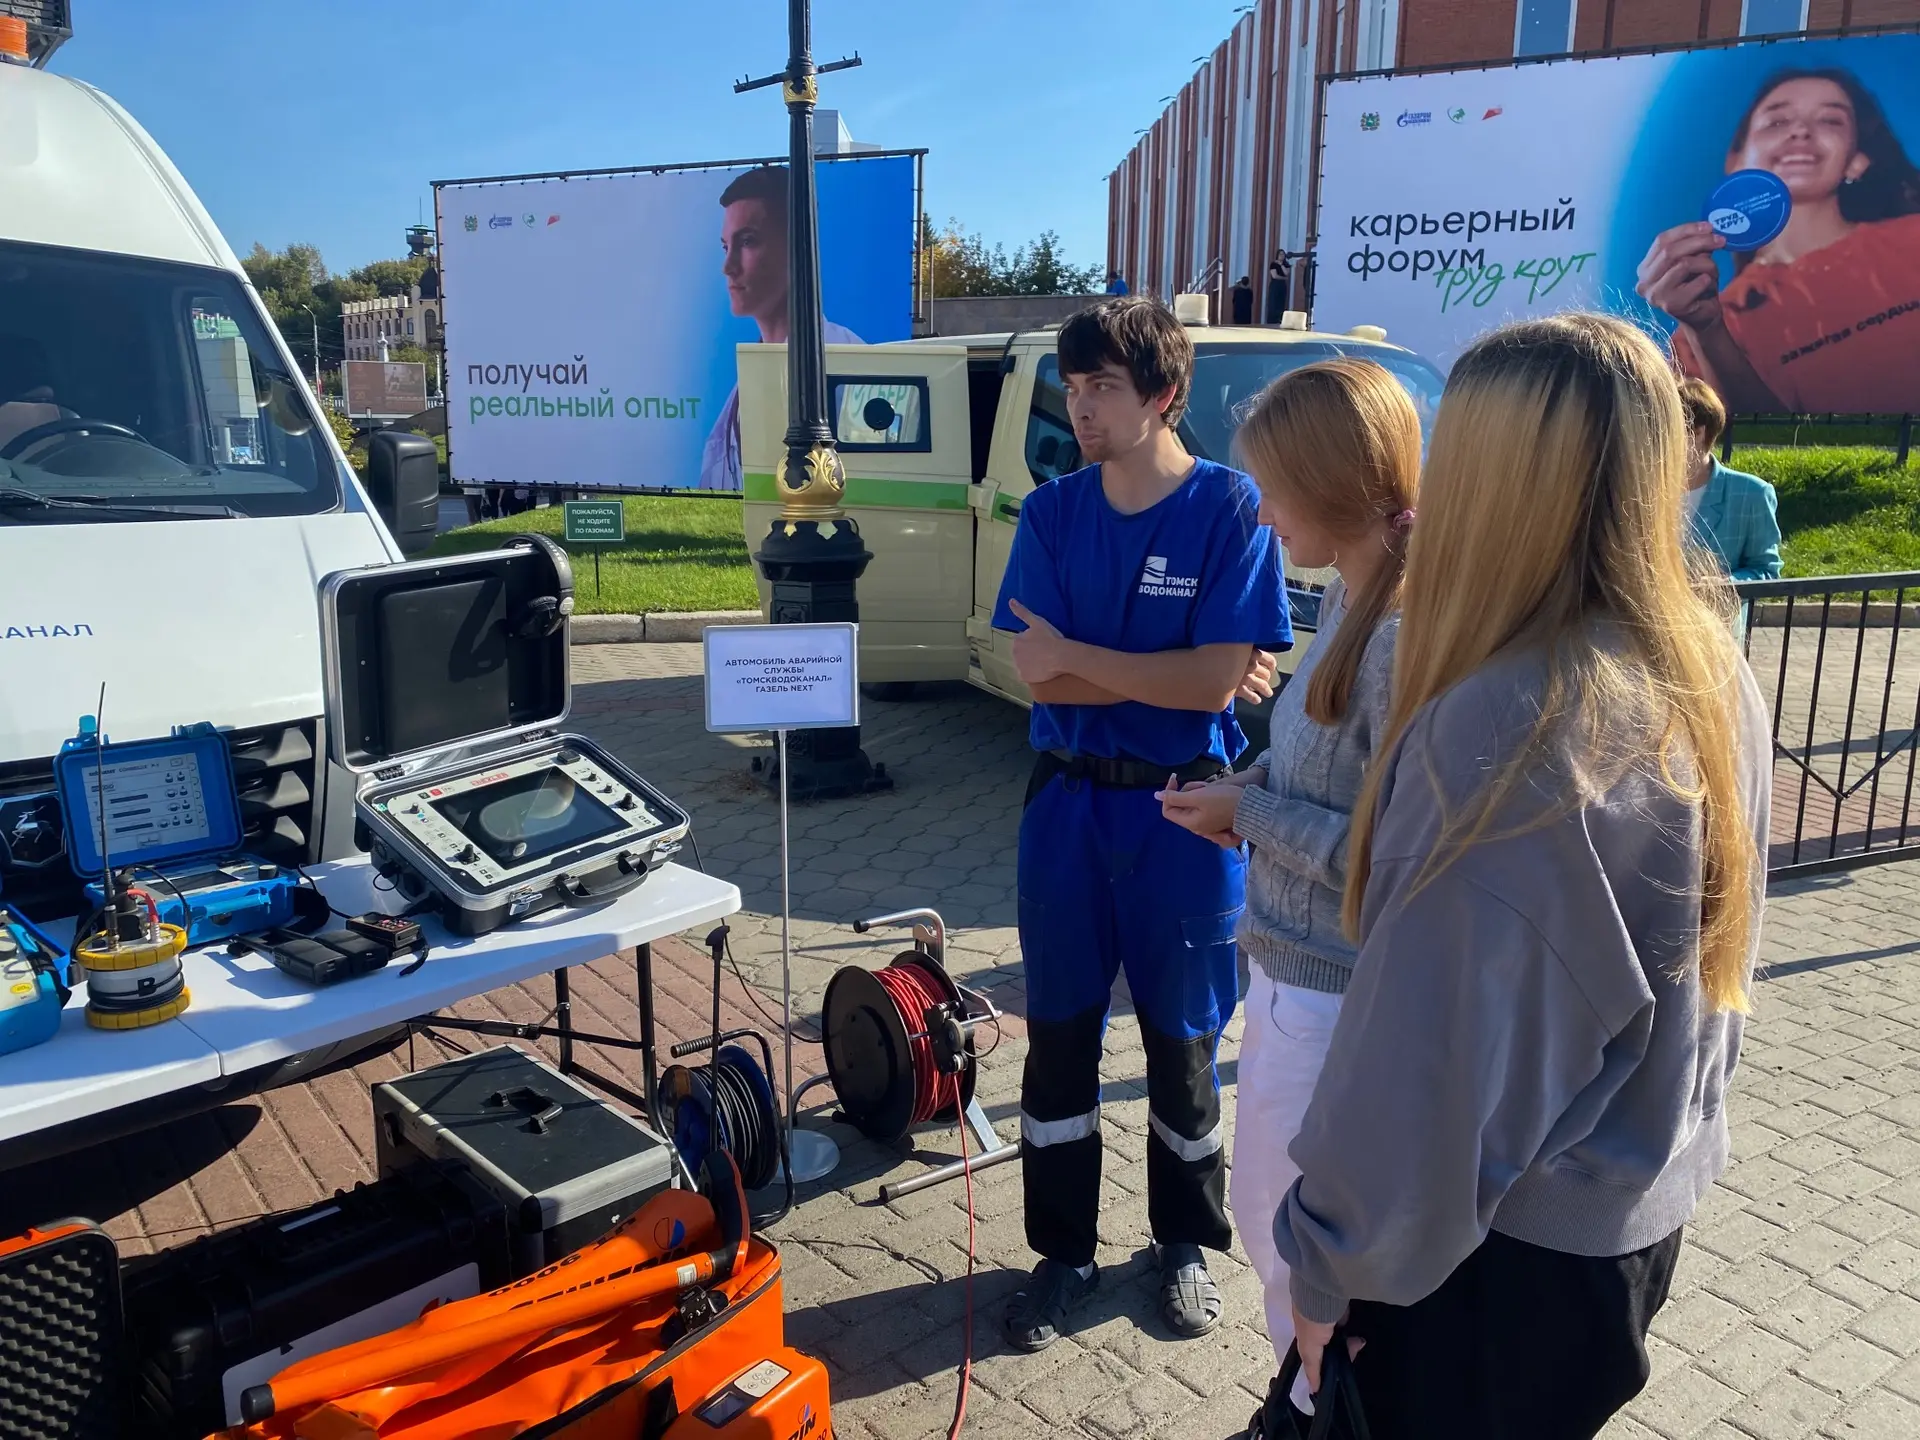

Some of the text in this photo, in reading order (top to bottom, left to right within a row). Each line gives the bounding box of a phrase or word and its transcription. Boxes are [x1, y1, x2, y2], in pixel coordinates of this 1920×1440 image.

[1349, 197, 1576, 245] карьерный
[1347, 244, 1486, 282] форум
[1434, 252, 1597, 313] труд крут
[467, 355, 588, 393] получай
[469, 388, 701, 424] реальный опыт
[1138, 584, 1197, 597] ВОДОКАНАЛ
[1165, 576, 1198, 587] ТОМСК
[0, 624, 94, 639] АНАЛ
[724, 655, 842, 666] АВТОМОБИЛЬ АВАРИЙНОЙ
[736, 675, 832, 684] «ТОМСКВОДОКАНАЛ»
[755, 685, 788, 693] ГАЗЕЛЬ
[137, 977, 157, 997] B
[487, 1253, 582, 1298] 9000
